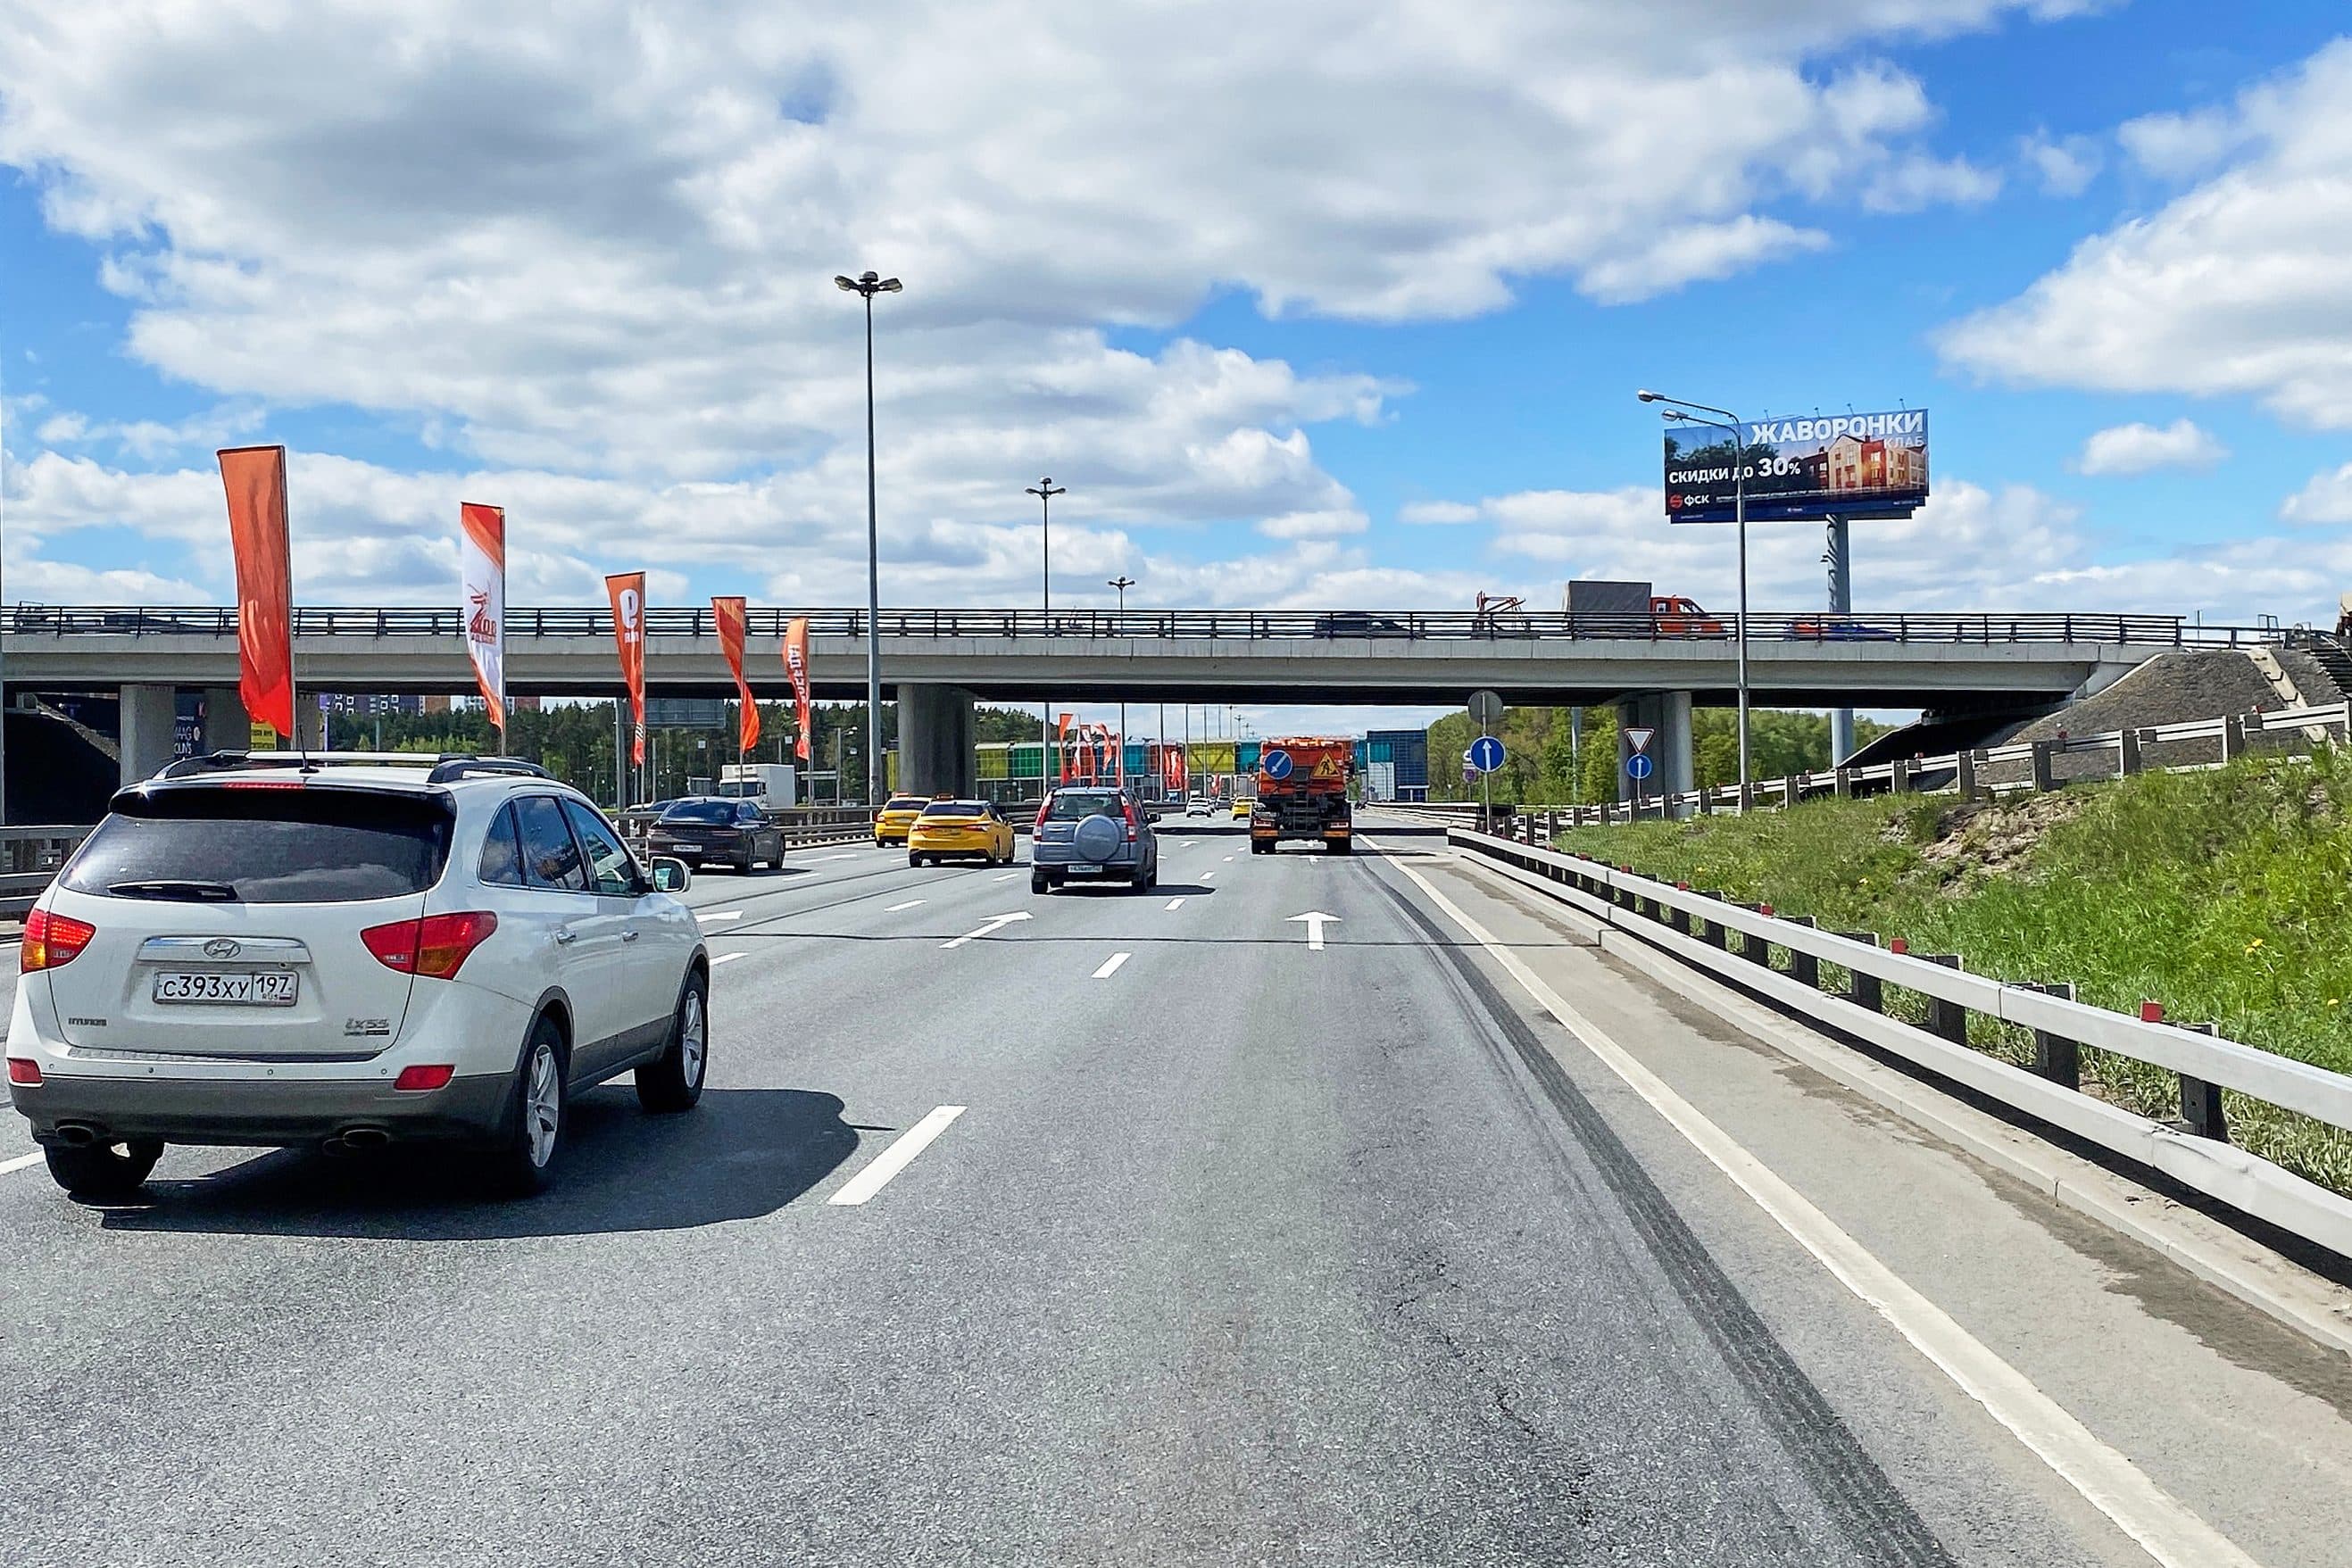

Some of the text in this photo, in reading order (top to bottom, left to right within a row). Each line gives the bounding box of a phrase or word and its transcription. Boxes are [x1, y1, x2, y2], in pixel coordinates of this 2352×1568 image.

[1751, 412, 1924, 445] ЖАВОРОНКИ
[1884, 436, 1925, 448] КЛАБ
[1669, 468, 1729, 484] СКИДКИ
[1758, 457, 1801, 477] 30%
[1683, 494, 1710, 506] ФСК
[255, 976, 290, 993] 197
